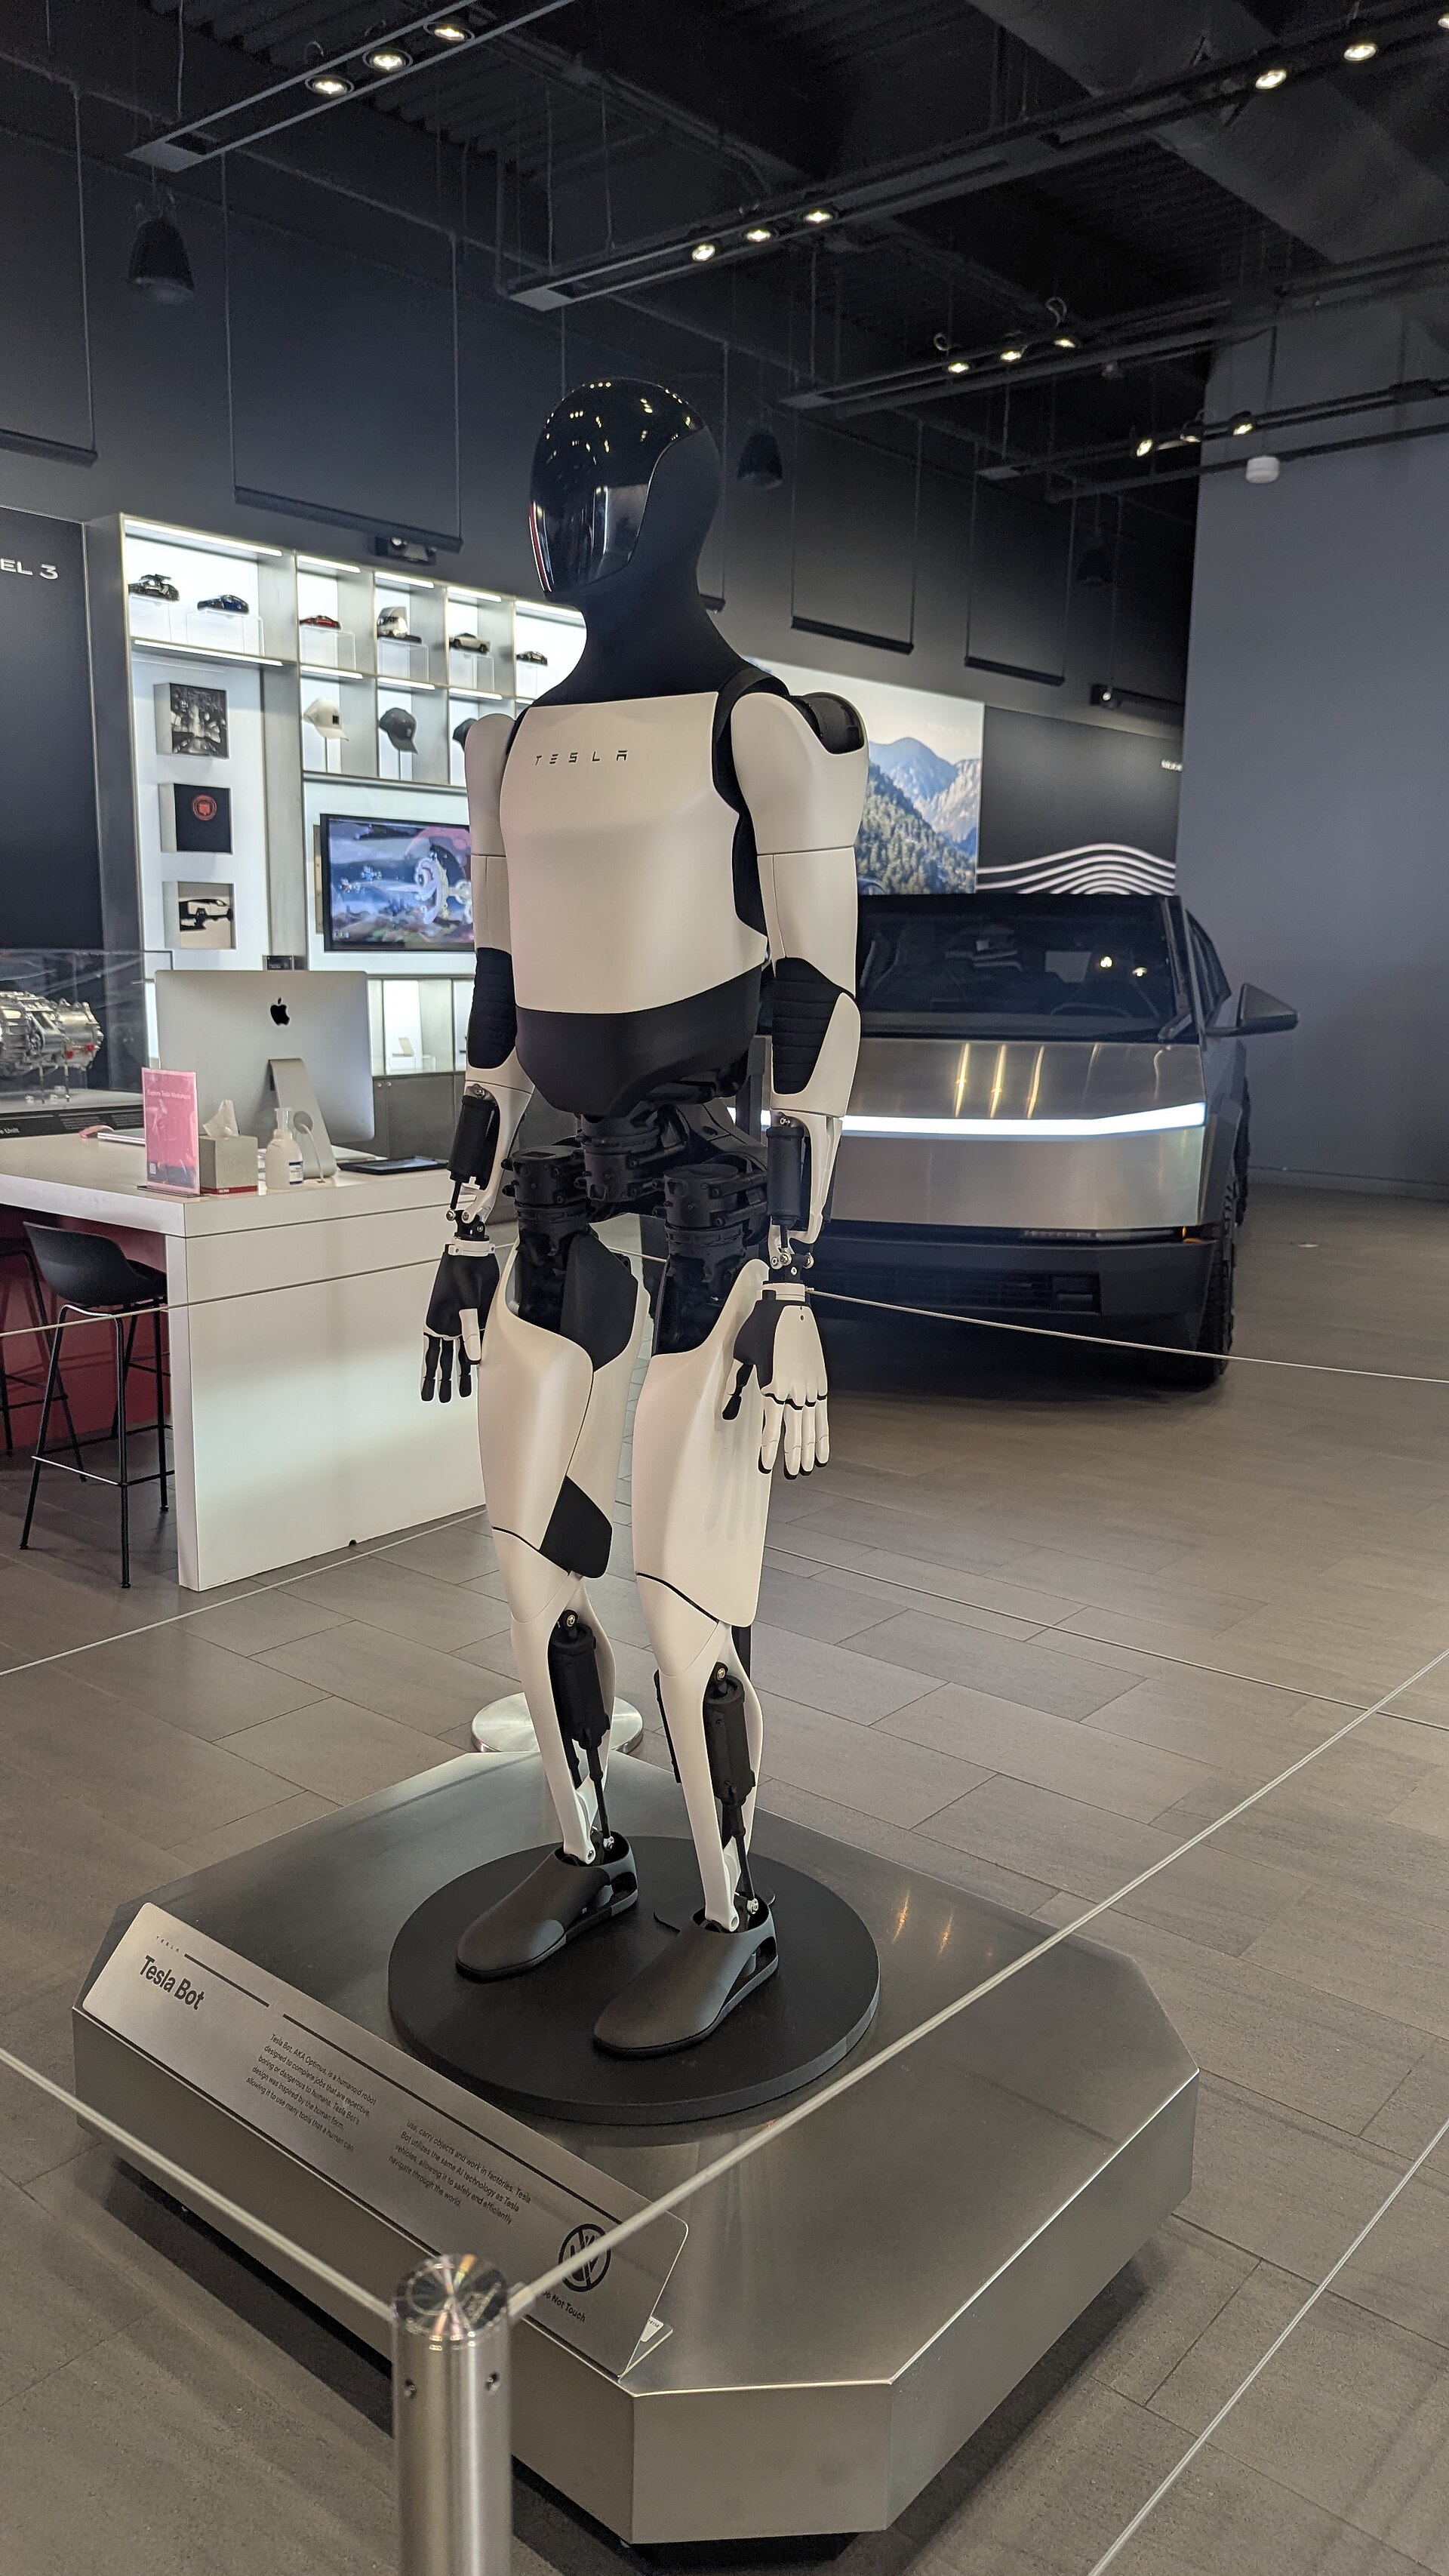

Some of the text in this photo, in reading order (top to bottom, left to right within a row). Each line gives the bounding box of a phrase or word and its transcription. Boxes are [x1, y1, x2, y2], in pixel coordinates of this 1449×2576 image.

[39, 563, 58, 580] 3
[534, 749, 628, 765] TESLA
[155, 1936, 180, 1953] TESLA
[140, 1954, 205, 2011] Tesla Bot
[253, 2067, 269, 2080] design
[269, 2078, 278, 2086] was
[278, 2082, 300, 2099] inspired
[306, 2101, 314, 2110] the
[314, 2106, 331, 2121] human
[258, 2055, 274, 2070] boring
[280, 2070, 305, 2089] dangerous
[333, 2102, 346, 2116] Tesla
[264, 2045, 288, 2062] designed
[292, 2064, 315, 2080] complete
[313, 2077, 326, 2088] jobs
[326, 2085, 337, 2094] that
[337, 2091, 345, 2100] are
[270, 2033, 283, 2046] Tesla
[293, 2049, 305, 2060] AKA
[337, 2076, 362, 2095] humanoid
[361, 2093, 376, 2105] robot
[246, 2078, 266, 2094] allowing
[276, 2097, 285, 2106] use
[285, 2104, 299, 2116] many
[299, 2111, 312, 2124] tools
[312, 2119, 323, 2131] that
[326, 2129, 343, 2144] human
[344, 2142, 353, 2152] can
[389, 2156, 411, 2174] navigate
[412, 2171, 434, 2188] through
[434, 2185, 444, 2195] the
[401, 2131, 411, 2142] Bot
[411, 2140, 431, 2154] utilizes
[431, 2151, 440, 2161] the
[441, 2158, 456, 2171] same
[464, 2171, 496, 2197] technology
[504, 2196, 518, 2211] Tesla
[419, 2129, 434, 2142] carry
[434, 2138, 454, 2154] objects
[455, 2152, 466, 2162] and
[466, 2159, 481, 2171] work
[515, 2187, 531, 2203] Tesla
[419, 2160, 441, 2179] allowing
[454, 2183, 471, 2198] safely
[471, 2194, 484, 2204] and
[483, 2202, 512, 2224] efficiently
[552, 2294, 565, 2309] Not
[565, 2302, 586, 2323] Touch
